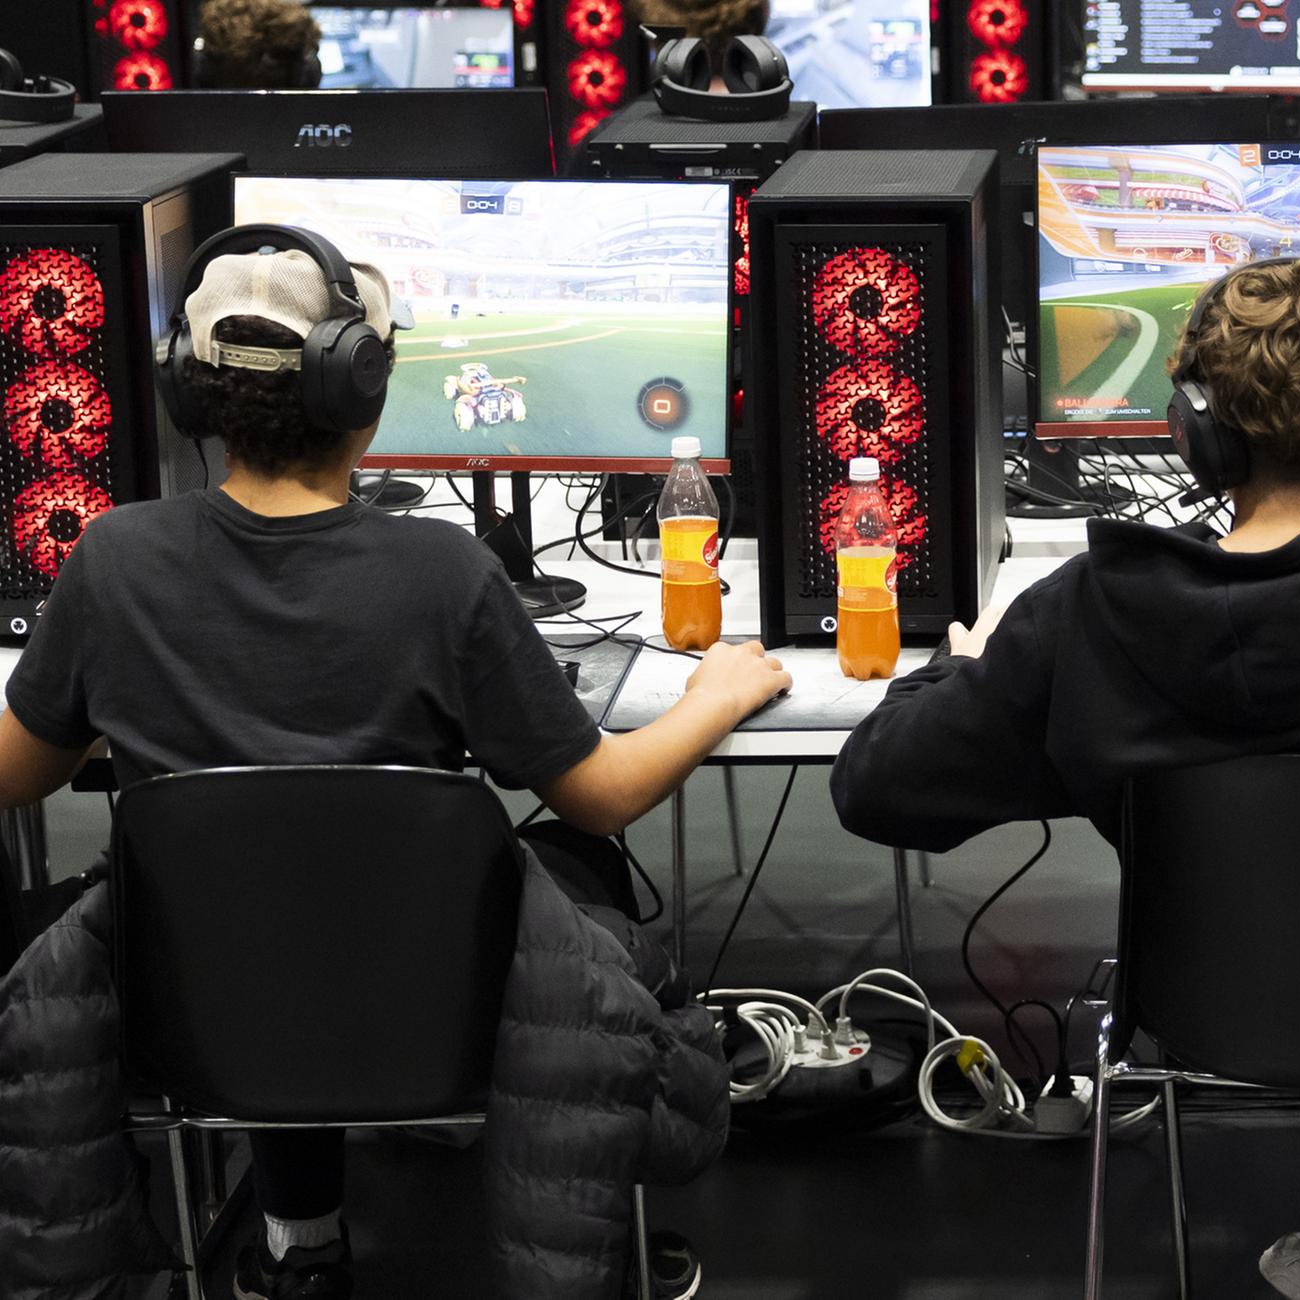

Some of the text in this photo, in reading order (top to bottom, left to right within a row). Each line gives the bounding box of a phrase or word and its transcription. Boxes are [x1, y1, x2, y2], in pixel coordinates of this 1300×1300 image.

[294, 124, 352, 147] AOC
[1244, 150, 1255, 162] 2
[1268, 150, 1300, 159] 0:04
[467, 201, 497, 209] 0:04
[654, 400, 670, 413] 0
